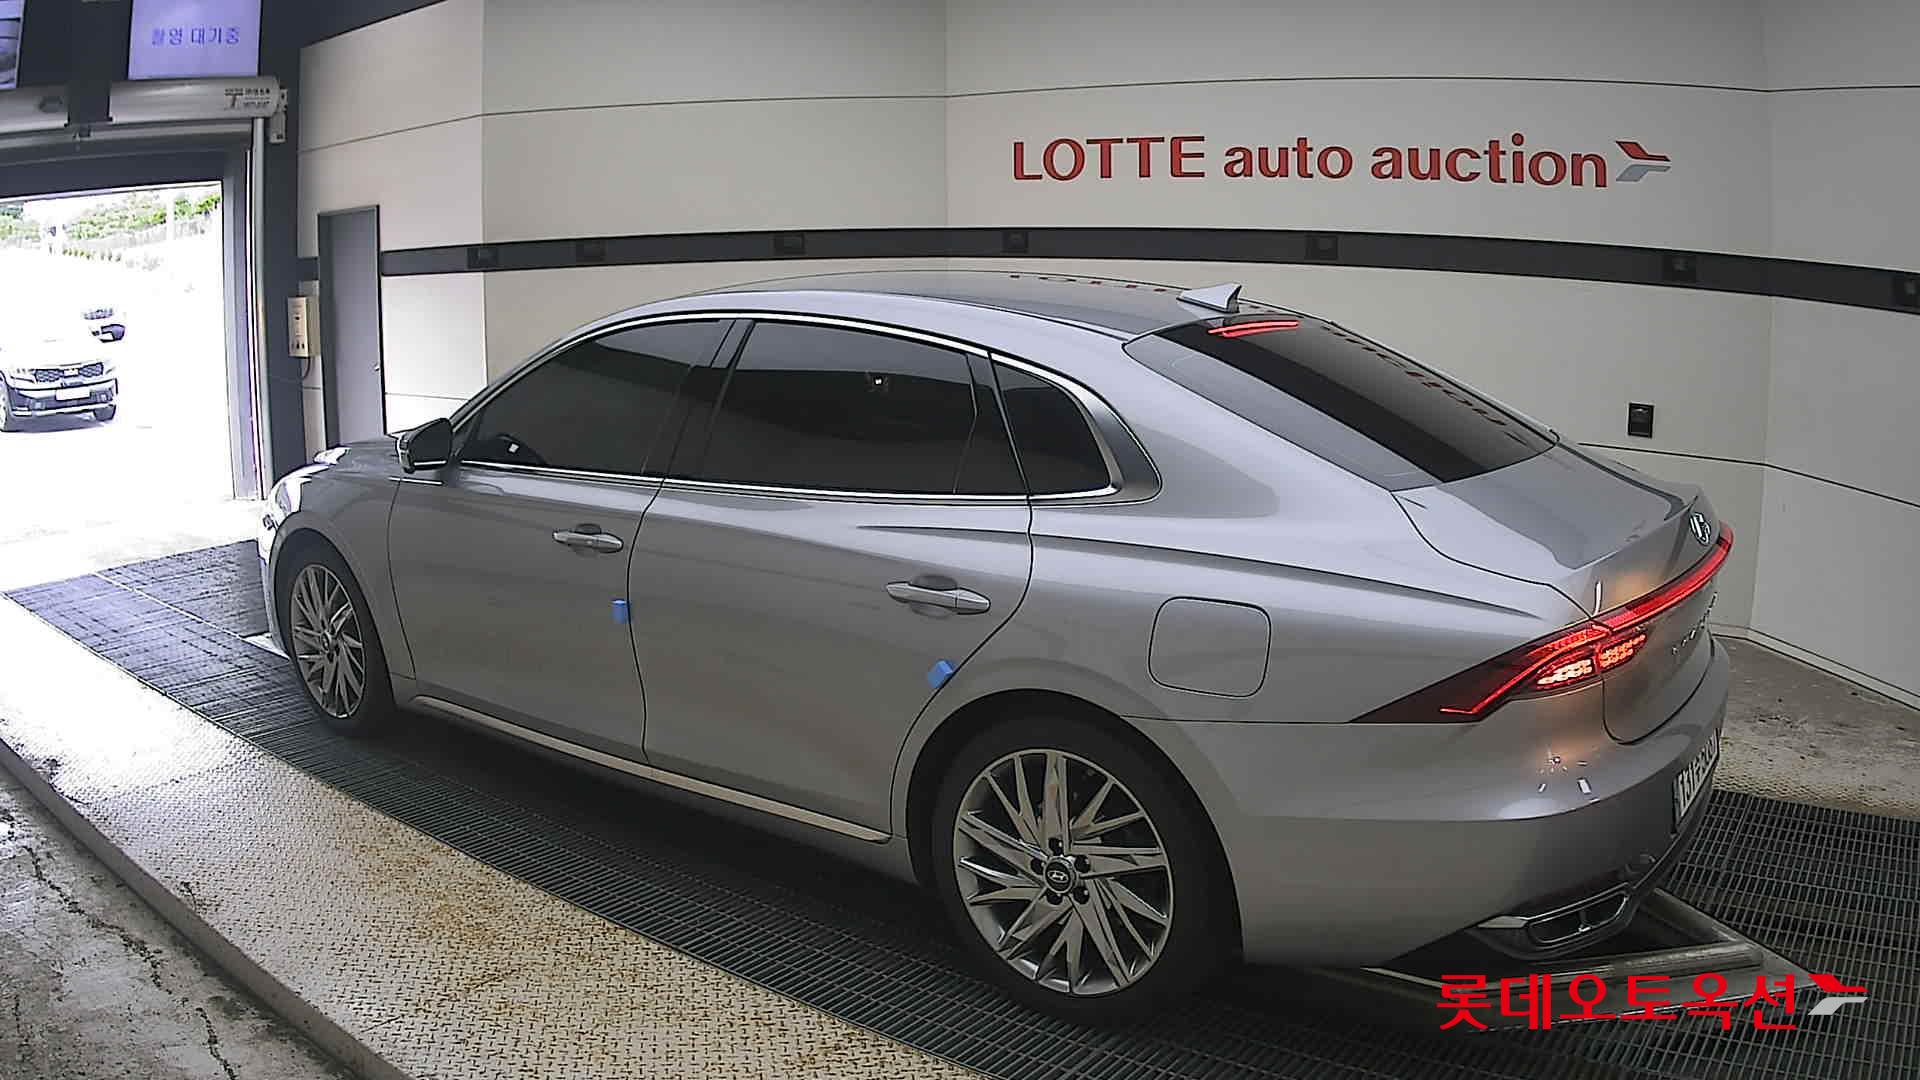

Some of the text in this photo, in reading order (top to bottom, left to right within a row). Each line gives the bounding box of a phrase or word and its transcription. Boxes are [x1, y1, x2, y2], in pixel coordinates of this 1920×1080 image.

[191, 26, 241, 46] 대기중
[1012, 133, 1608, 188] LOTTE auto auction
